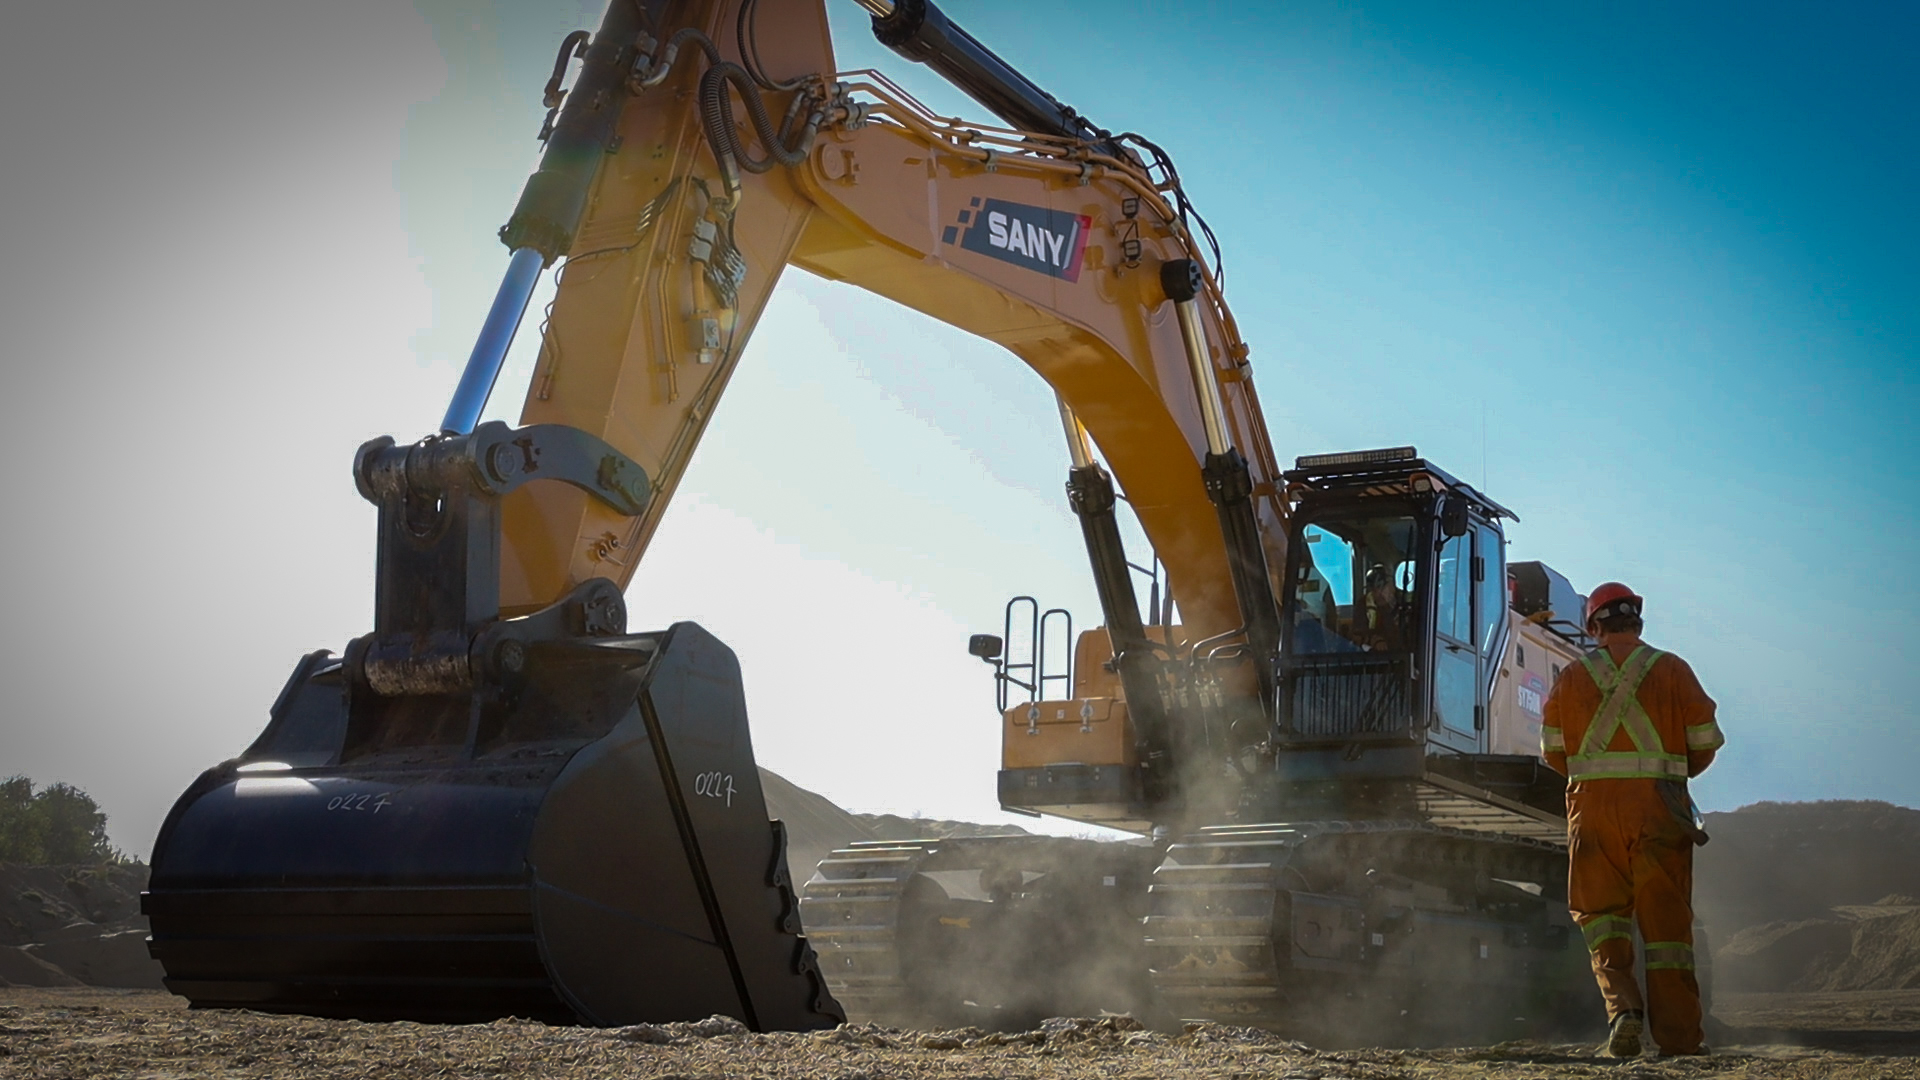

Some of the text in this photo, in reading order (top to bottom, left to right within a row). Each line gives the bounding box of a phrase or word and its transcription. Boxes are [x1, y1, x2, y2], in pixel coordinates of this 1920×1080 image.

[988, 210, 1065, 267] SANY
[327, 792, 392, 814] 0227
[695, 771, 738, 808] 0227
